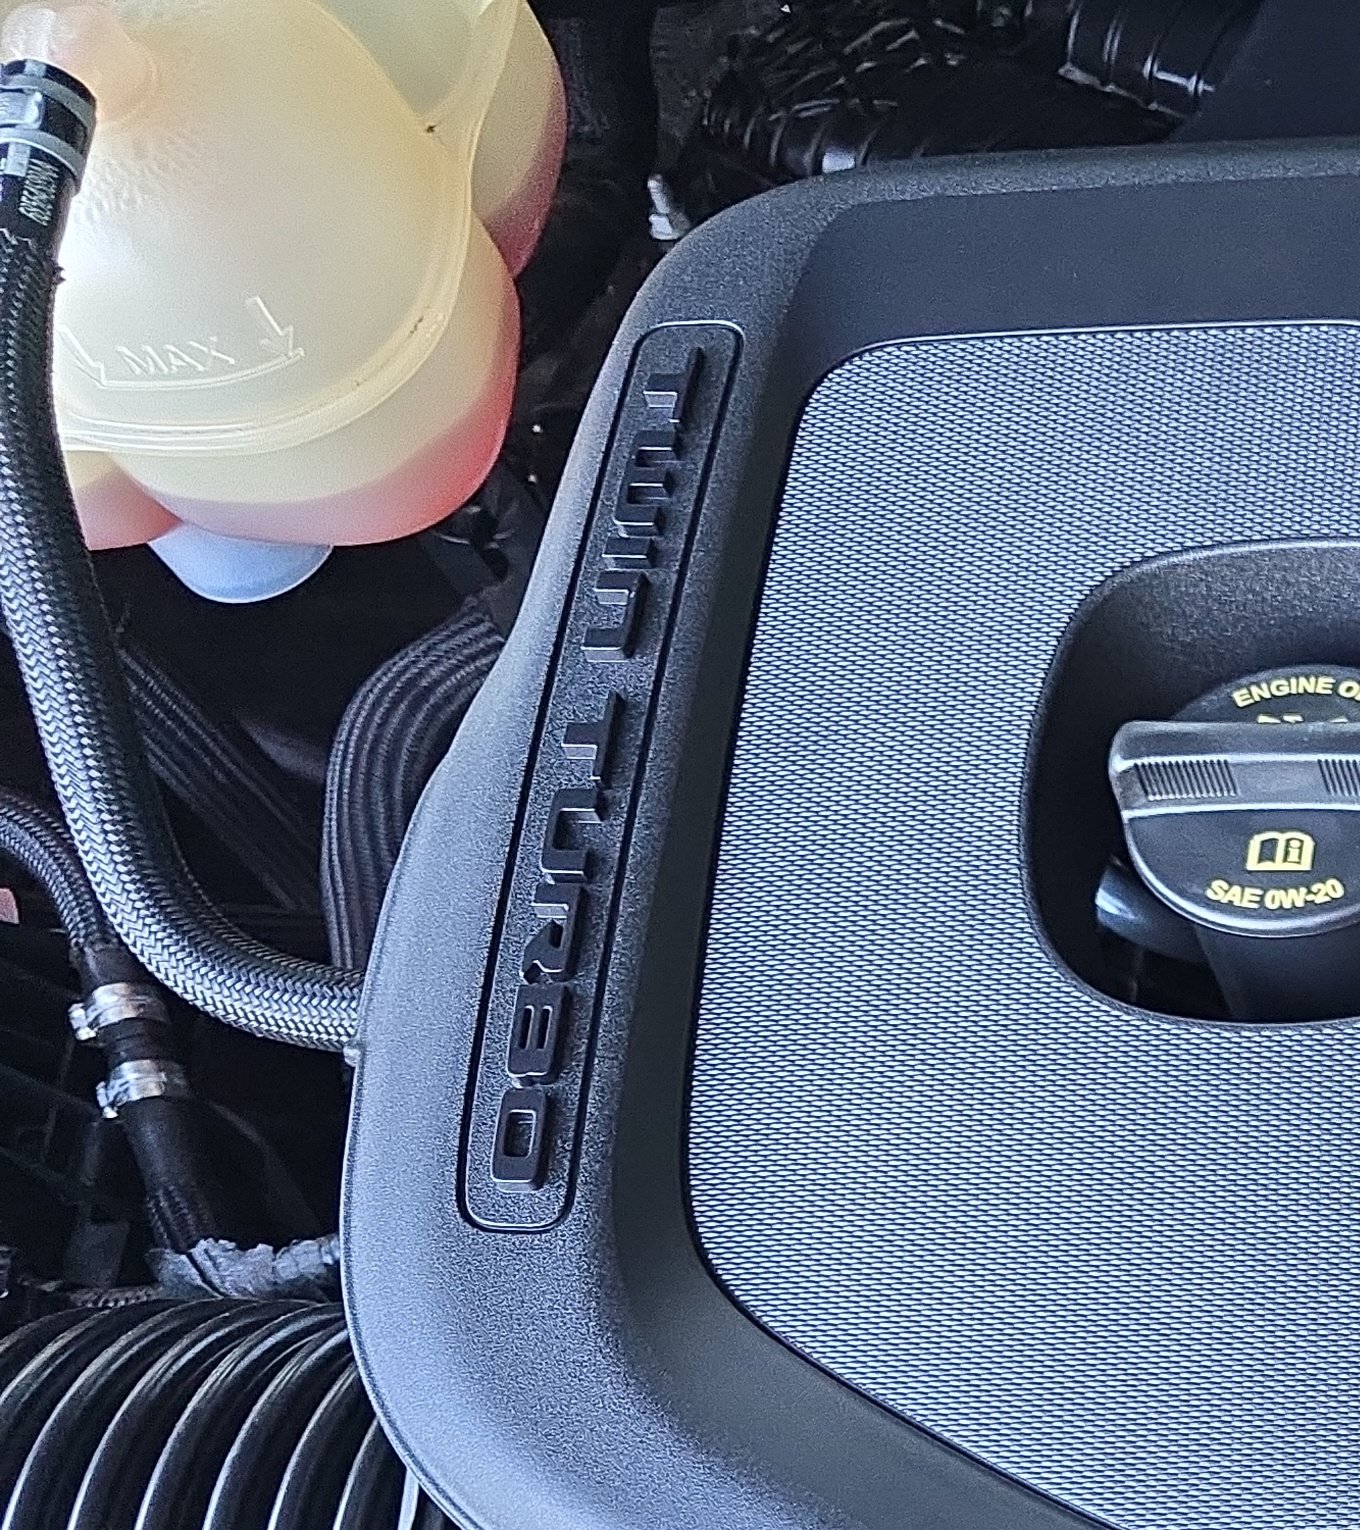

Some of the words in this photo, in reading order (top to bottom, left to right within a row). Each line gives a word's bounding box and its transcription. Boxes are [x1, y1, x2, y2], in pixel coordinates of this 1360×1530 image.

[115, 335, 236, 376] MAX
[582, 345, 710, 663] TWIN
[1232, 675, 1334, 708] ENGINE
[1205, 877, 1262, 909] SAE
[1264, 876, 1345, 909] 0W-20
[488, 689, 630, 1195] TURBO
